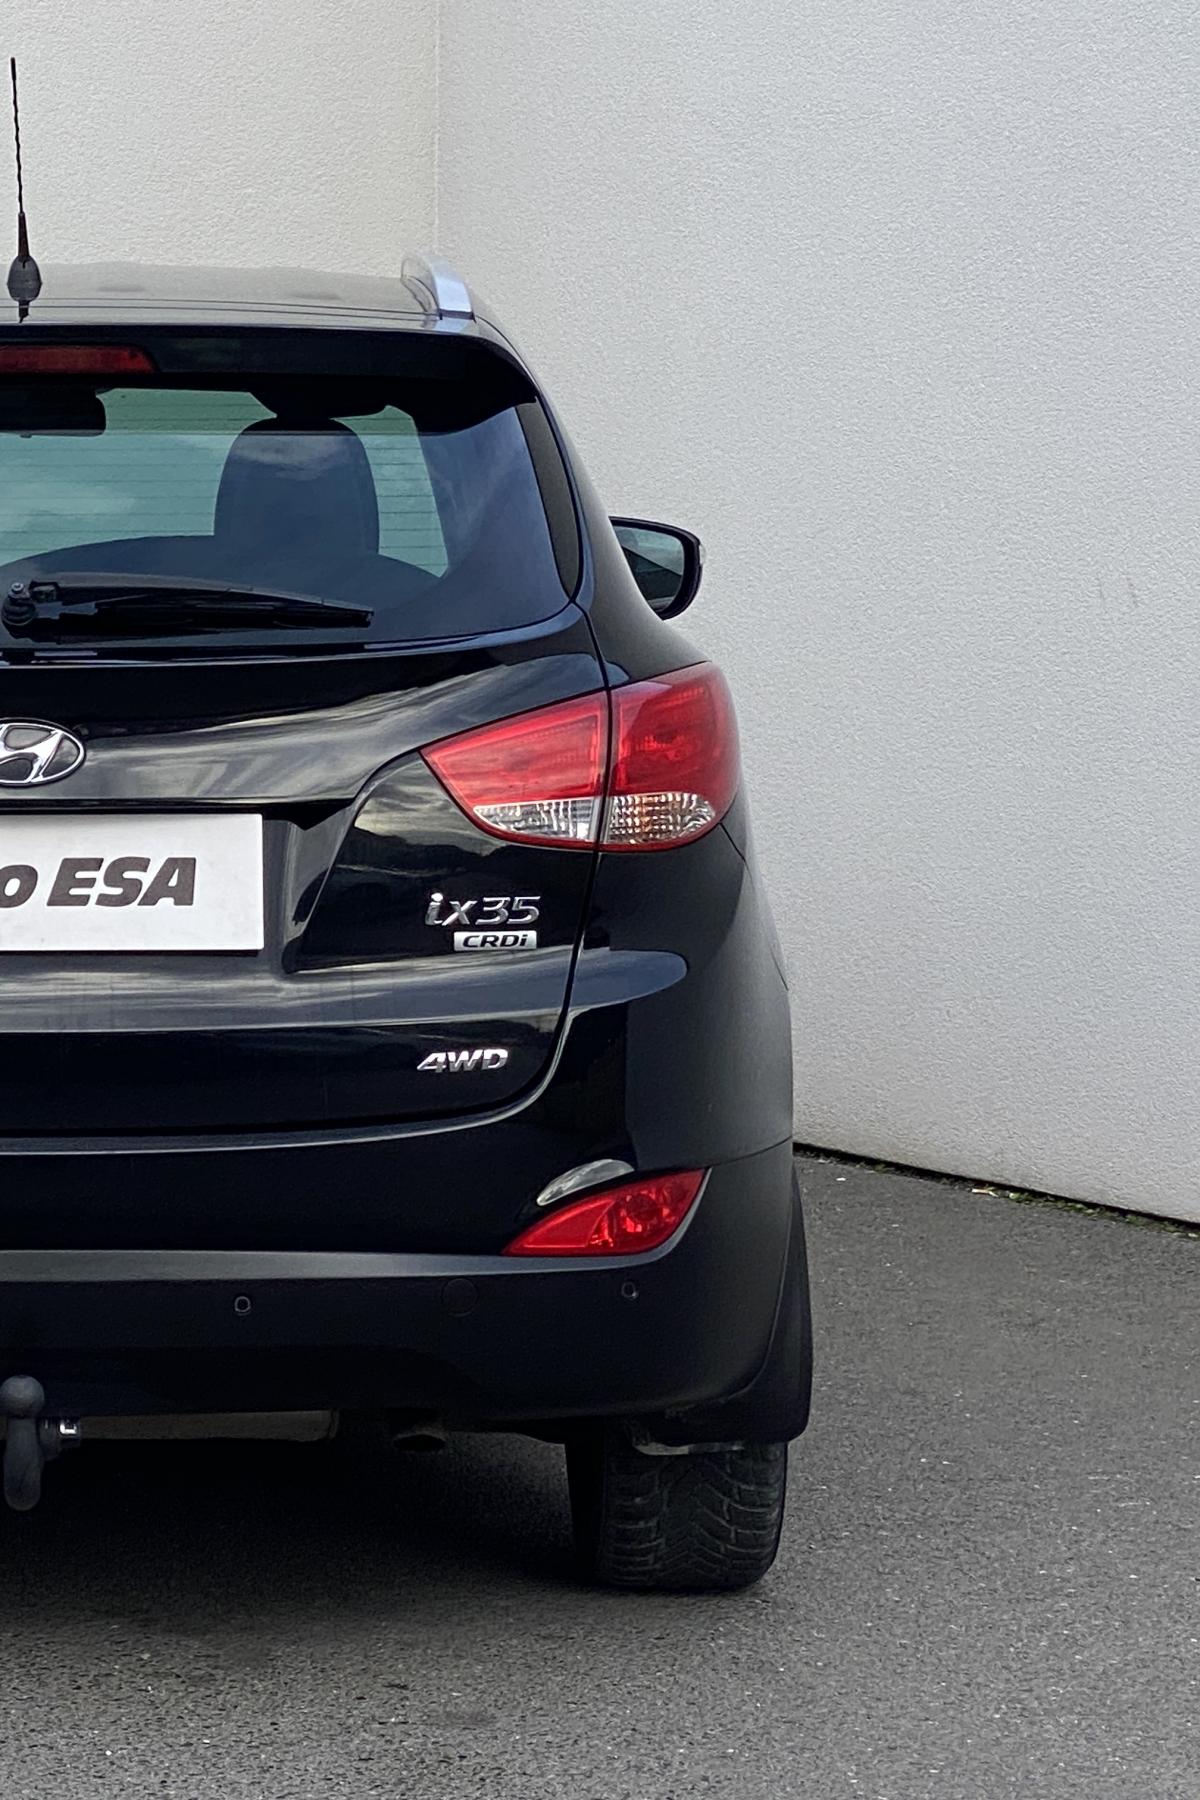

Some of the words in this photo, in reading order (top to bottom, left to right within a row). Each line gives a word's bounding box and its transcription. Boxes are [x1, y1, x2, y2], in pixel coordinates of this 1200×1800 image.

[46, 856, 197, 907] ESA
[425, 892, 541, 926] ix35
[462, 934, 528, 948] CRDi
[416, 1048, 509, 1073] 4WD
